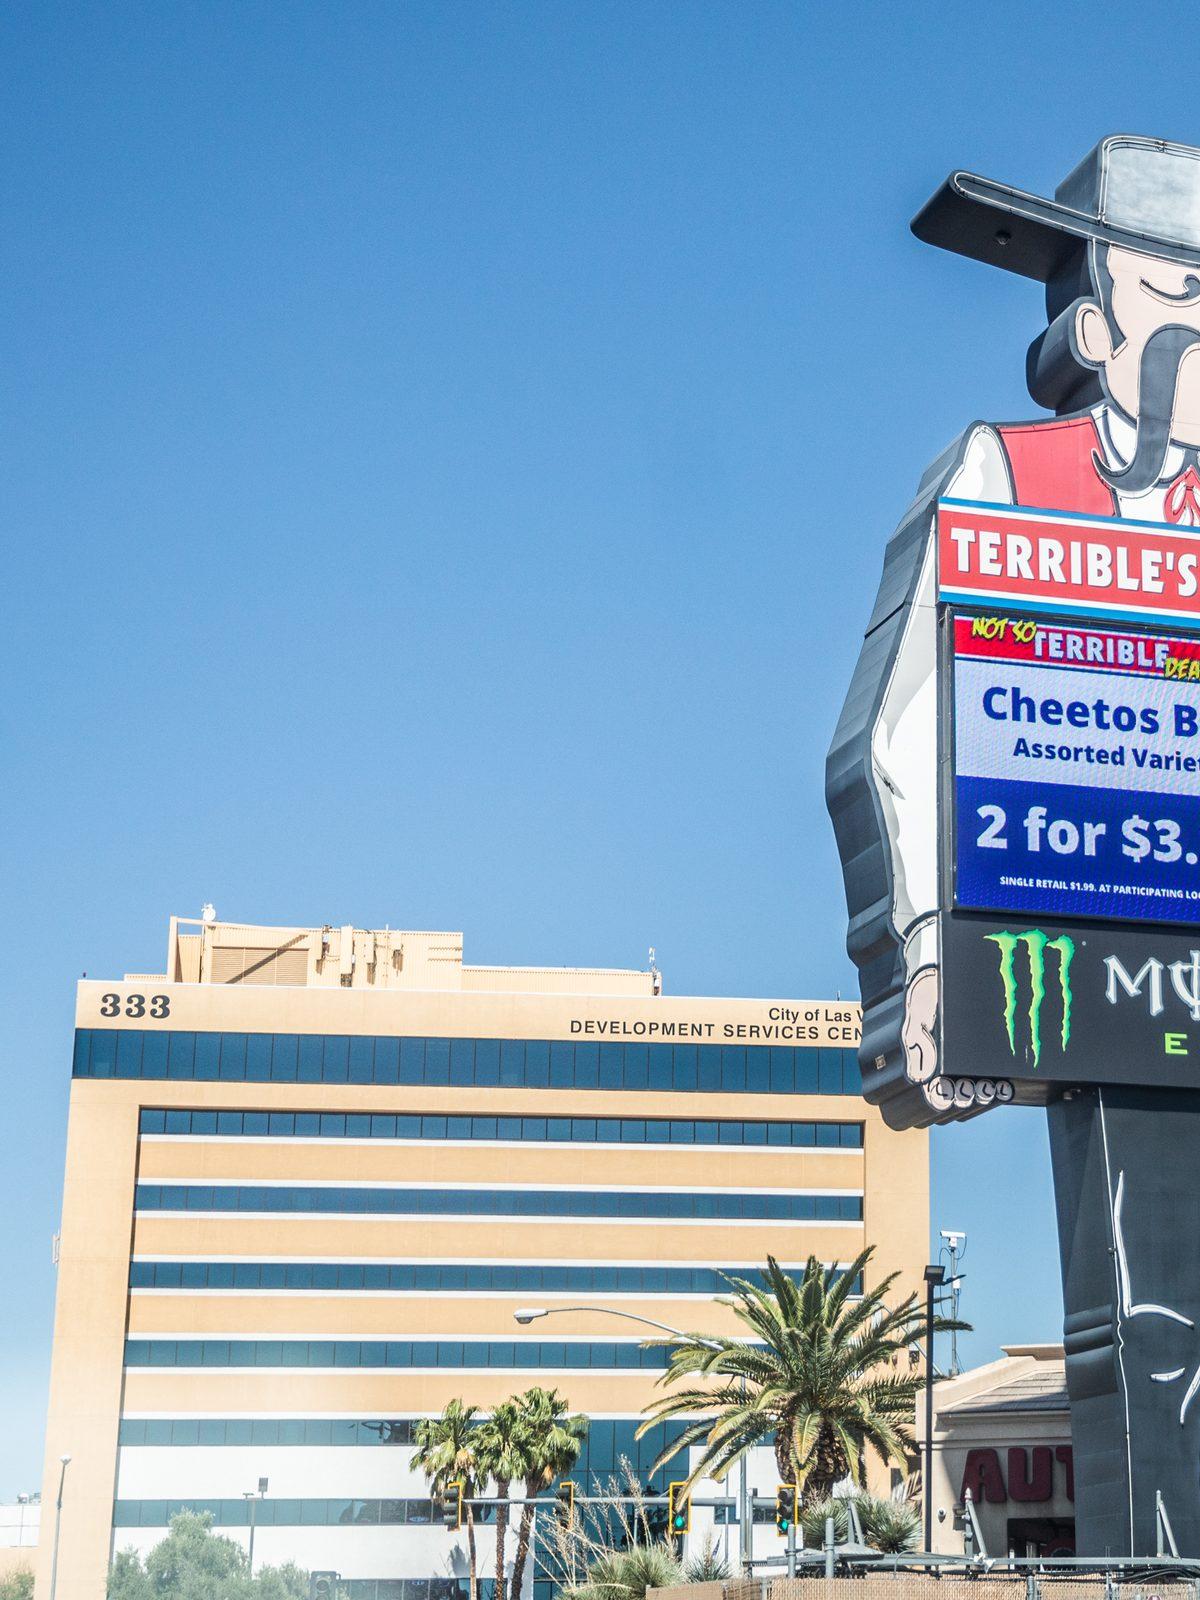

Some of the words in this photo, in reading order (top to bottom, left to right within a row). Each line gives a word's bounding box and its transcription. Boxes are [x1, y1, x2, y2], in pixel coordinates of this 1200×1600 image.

[950, 527, 1198, 597] TERRIBLE'S
[971, 617, 1009, 640] NOT
[1012, 619, 1037, 643] SO
[1034, 631, 1169, 668] TERRIBLE
[982, 686, 1160, 734] Cheetos
[1013, 738, 1125, 766] Assorted
[976, 804, 1008, 849] 2
[1023, 806, 1106, 856] for
[999, 875, 1034, 887] SINGLE
[1036, 879, 1068, 890] RETAIL
[1070, 881, 1097, 892] $1.99.
[1099, 884, 1112, 893] AT
[1113, 885, 1184, 899] PARTICIPATING
[100, 993, 170, 1019] 333
[769, 1007, 799, 1024] City
[804, 1009, 820, 1021] of
[825, 1009, 852, 1022] Las
[570, 1020, 715, 1037] DEVELOPMENT
[723, 1024, 819, 1040] SERVICES
[827, 1026, 863, 1041] CEN
